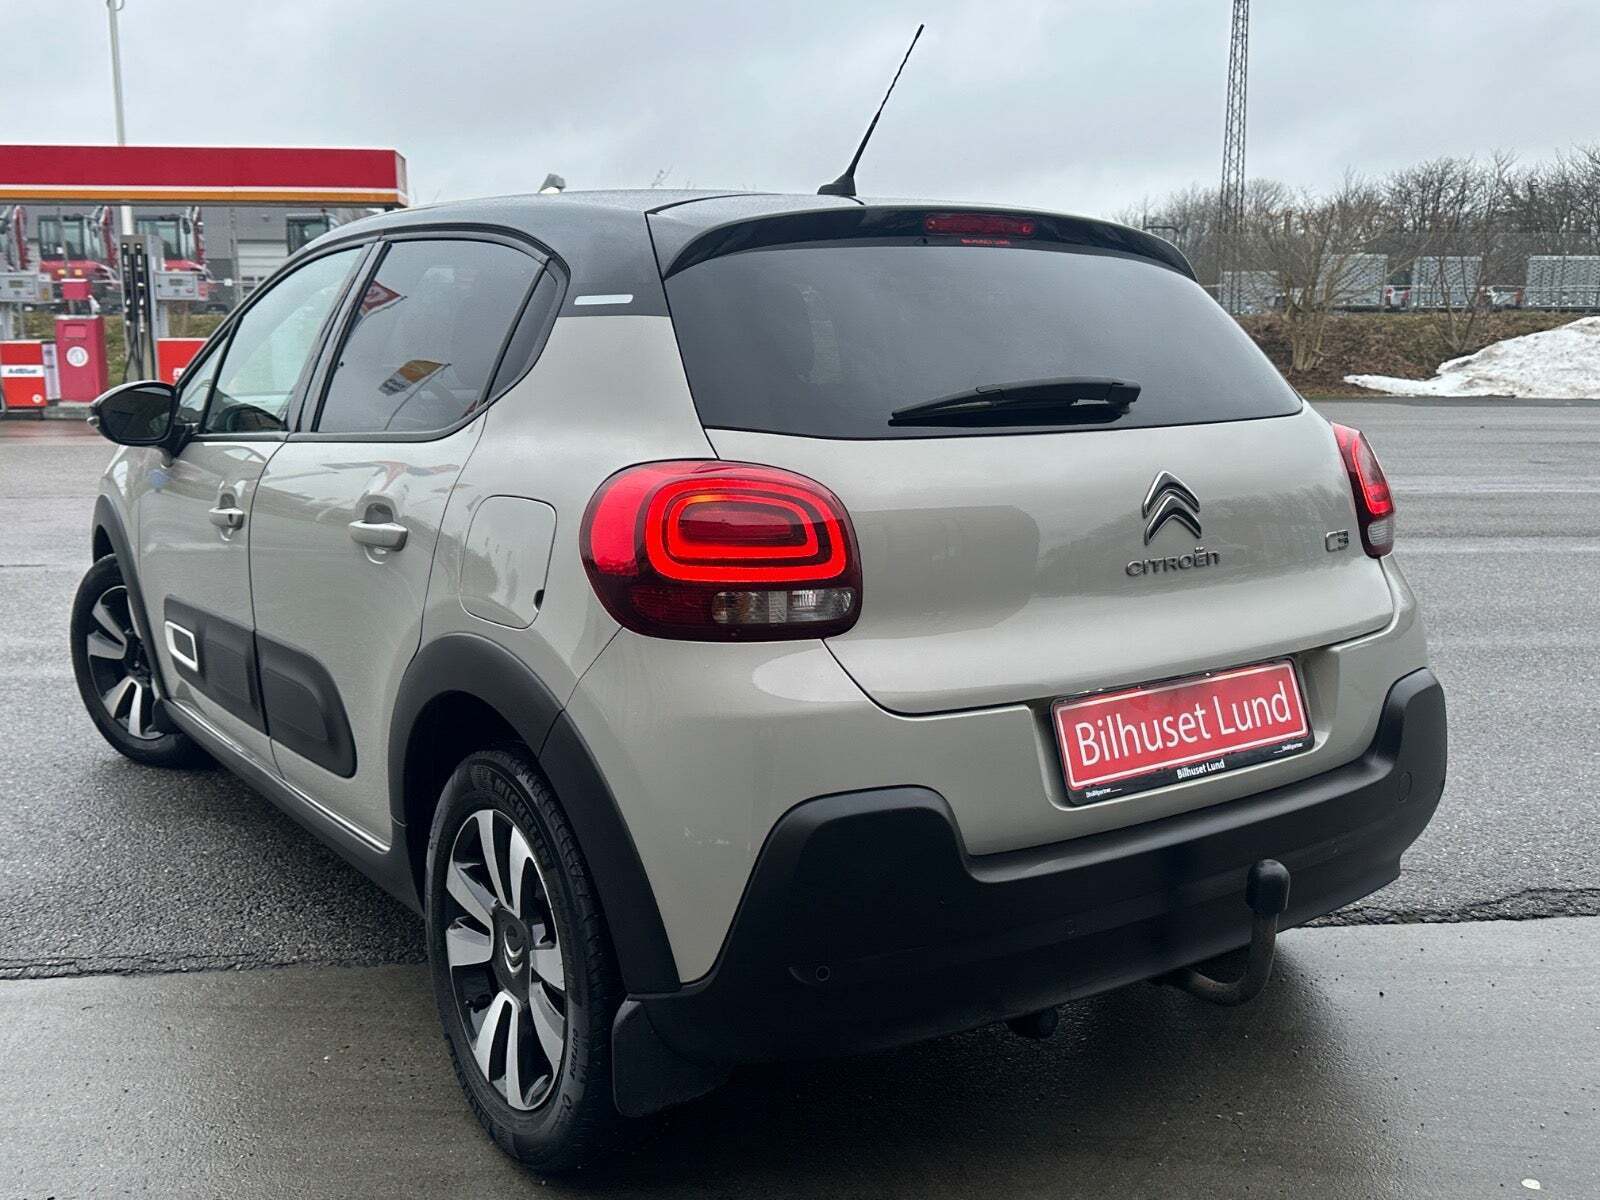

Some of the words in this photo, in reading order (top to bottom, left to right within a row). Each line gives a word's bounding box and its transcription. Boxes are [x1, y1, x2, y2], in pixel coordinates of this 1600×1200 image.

[1325, 529, 1349, 553] C3
[1075, 703, 1211, 766] Bilhuset
[1212, 680, 1292, 736] Lund
[1176, 764, 1206, 780] Bilhuset
[1207, 759, 1225, 774] Lund
